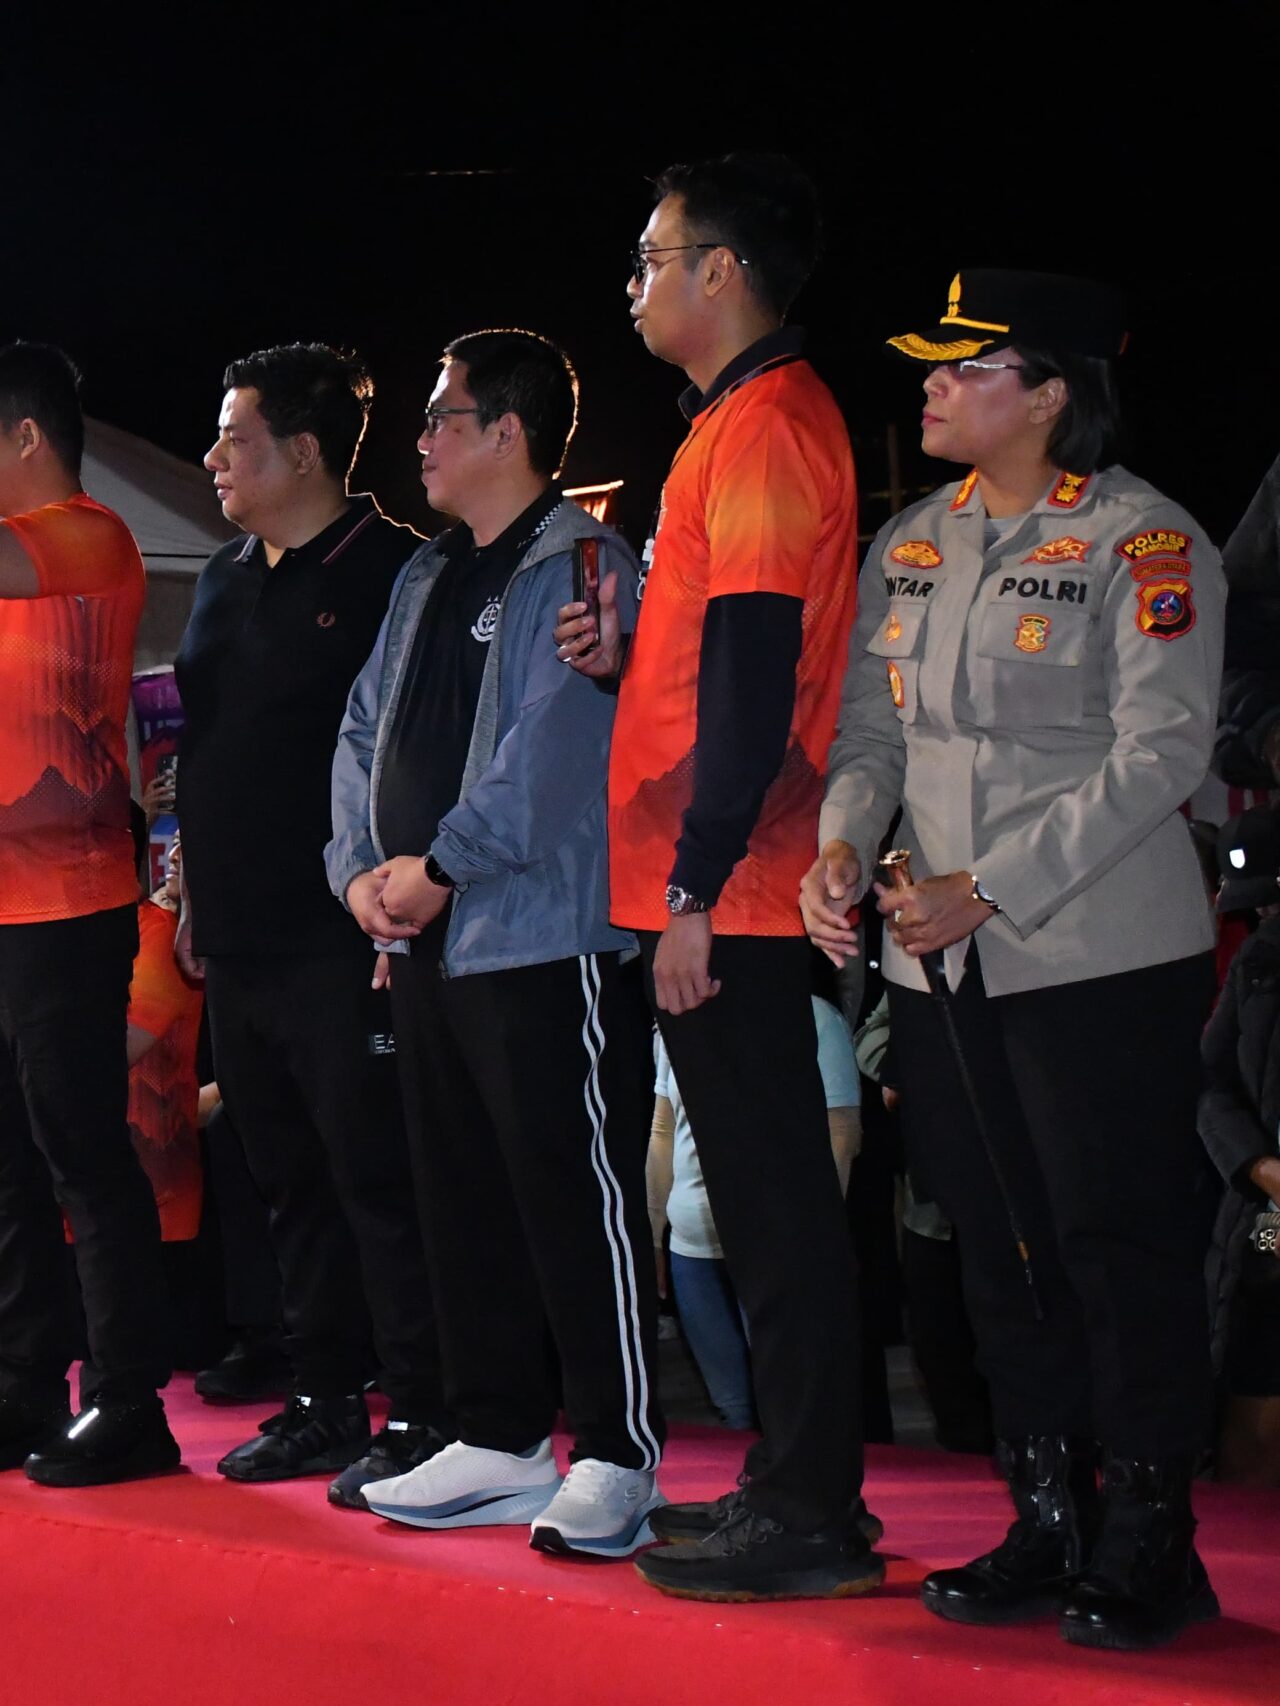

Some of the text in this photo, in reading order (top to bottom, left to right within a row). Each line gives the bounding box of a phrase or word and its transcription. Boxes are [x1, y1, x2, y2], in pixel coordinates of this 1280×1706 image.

[1124, 532, 1185, 555] POLRES
[885, 577, 934, 597] NTAR
[998, 577, 1087, 604] POLRI
